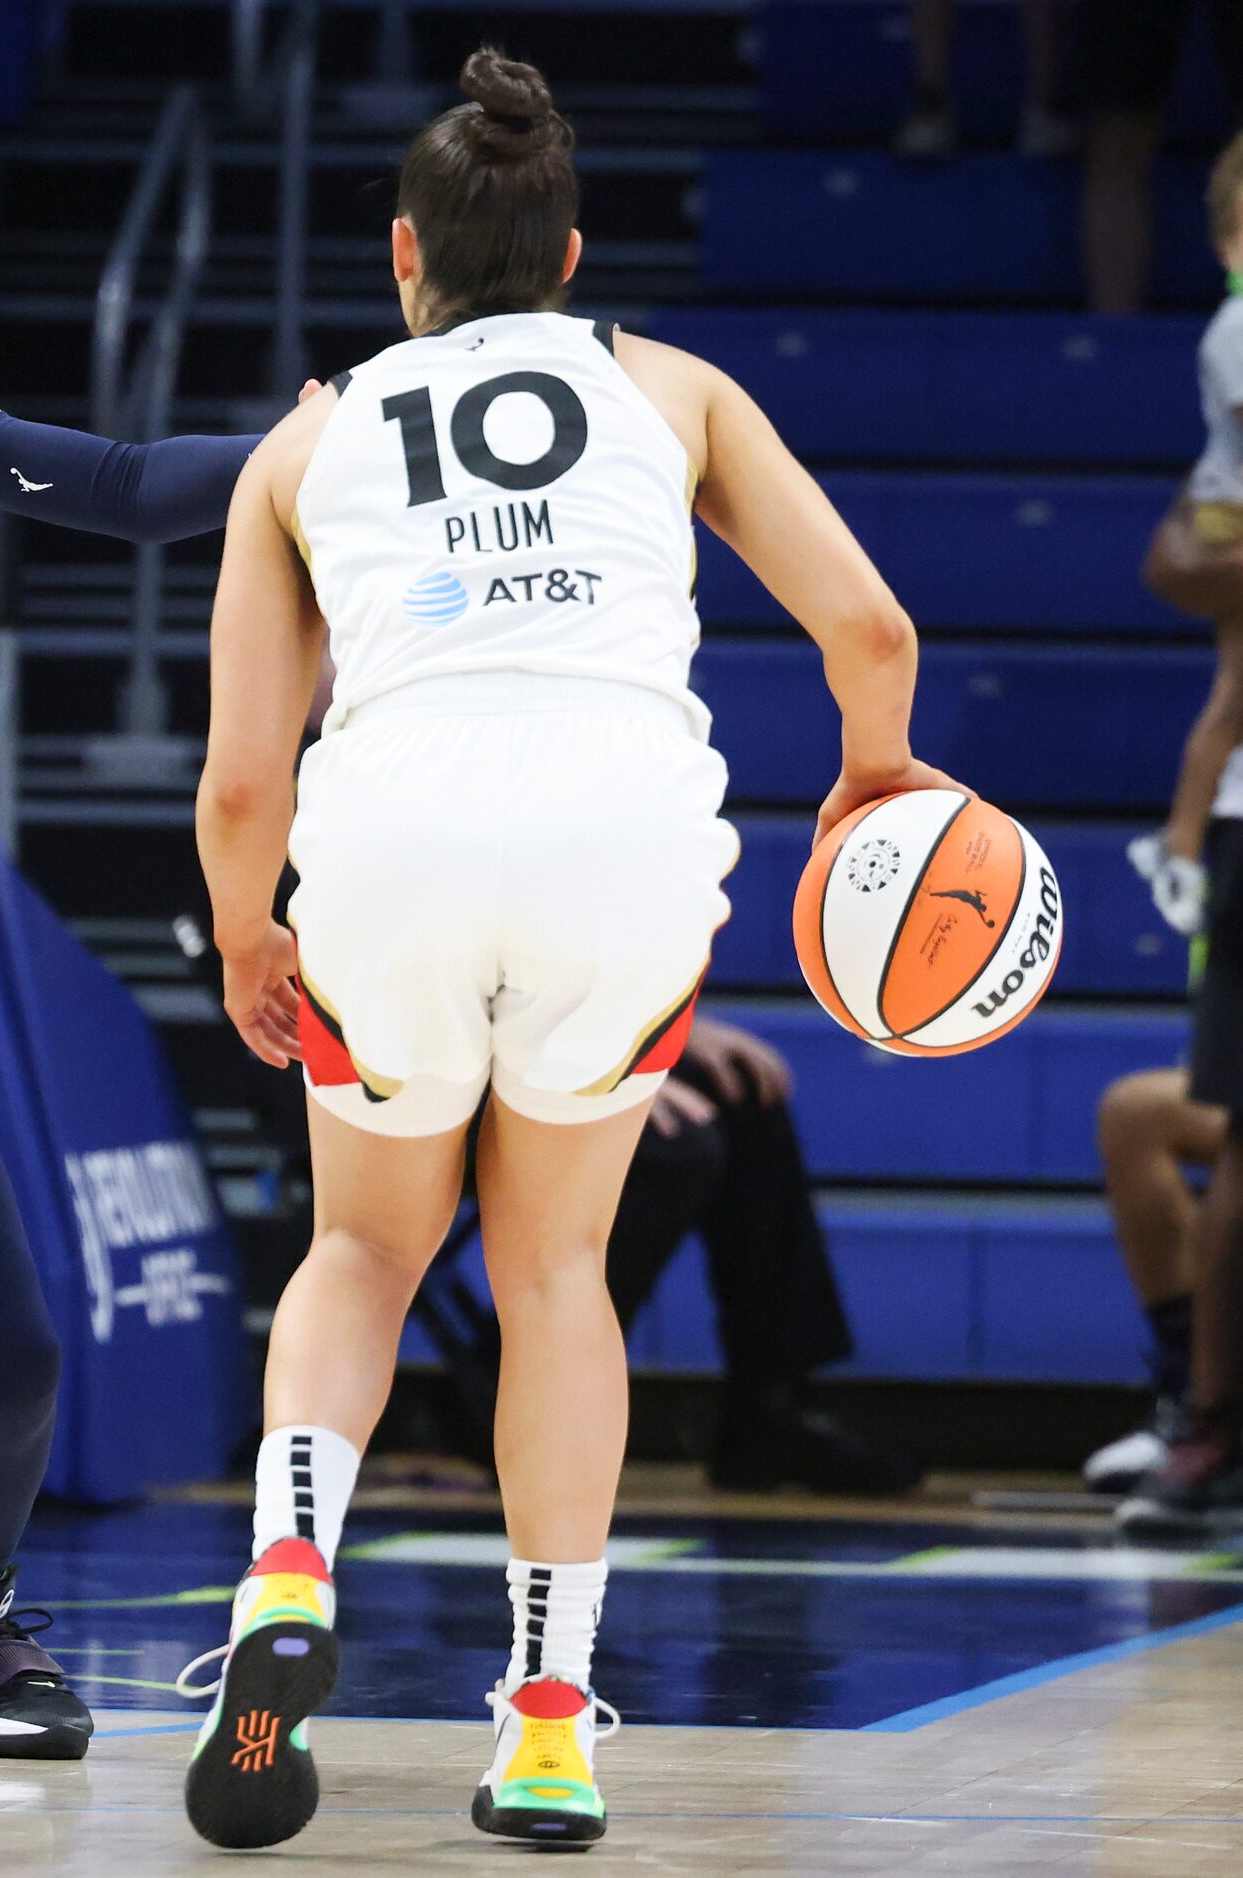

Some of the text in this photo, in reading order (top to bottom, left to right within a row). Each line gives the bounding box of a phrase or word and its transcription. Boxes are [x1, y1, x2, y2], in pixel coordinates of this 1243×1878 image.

[381, 370, 588, 508] 10
[445, 499, 553, 554] PLUM
[482, 568, 602, 606] AT&T
[971, 866, 1059, 1018] Wilson
